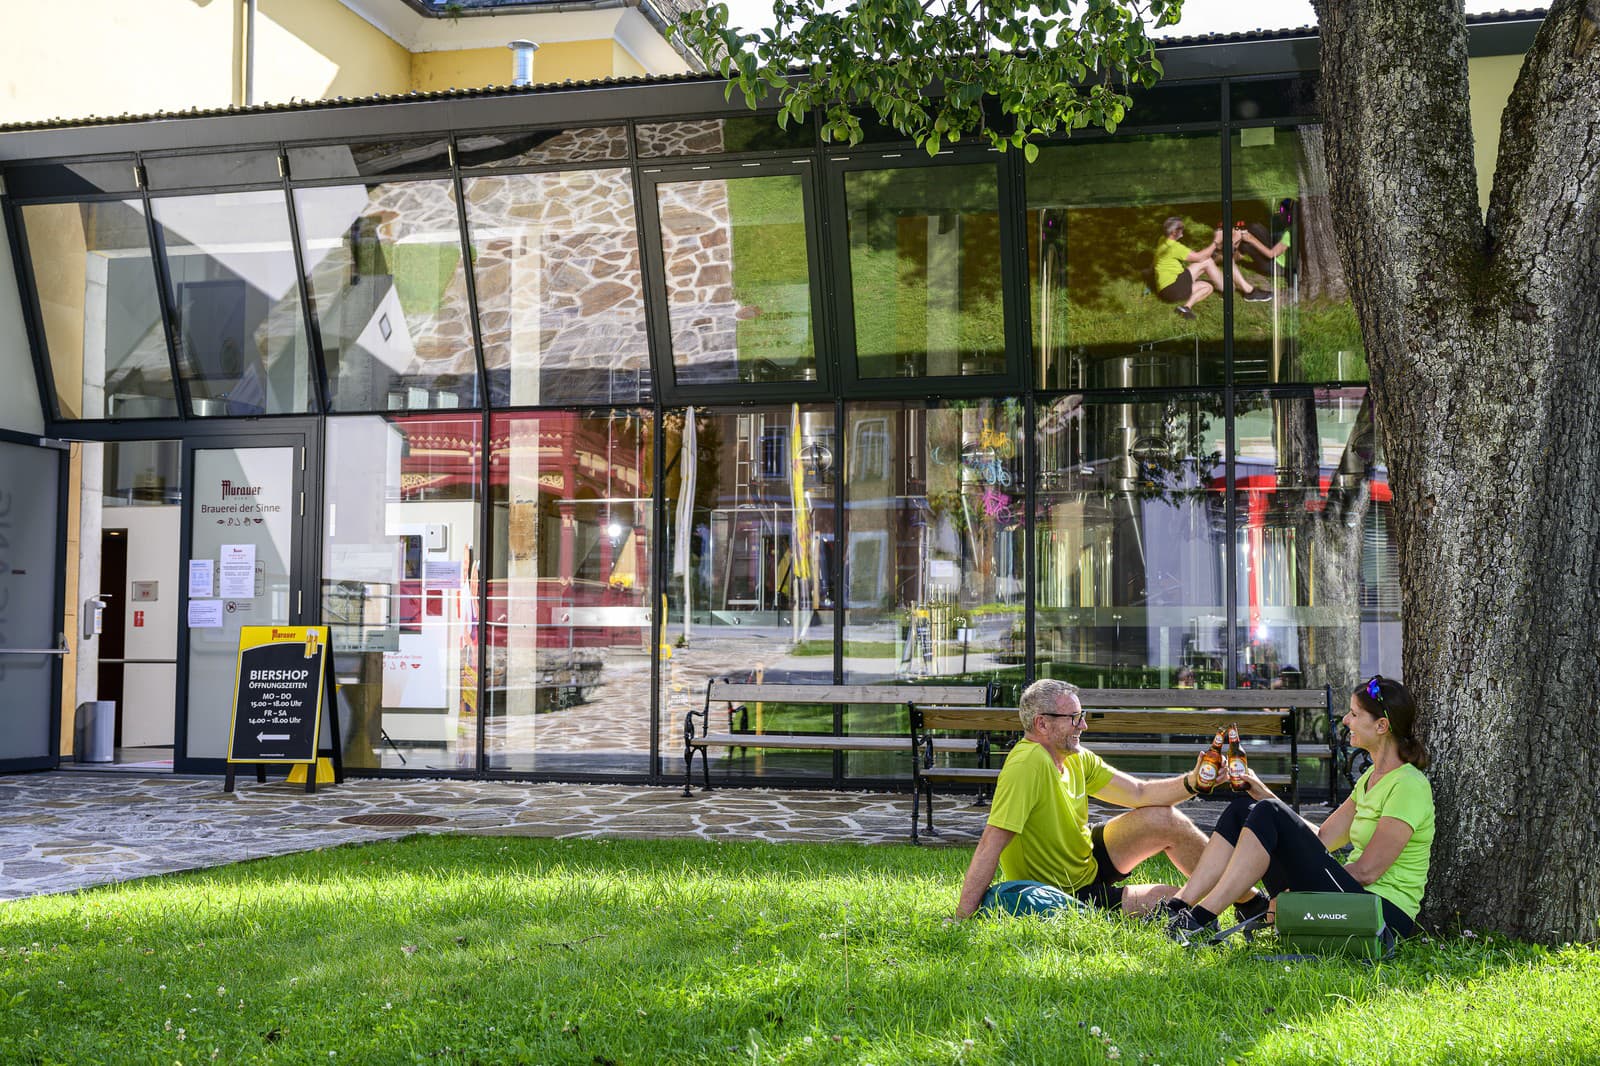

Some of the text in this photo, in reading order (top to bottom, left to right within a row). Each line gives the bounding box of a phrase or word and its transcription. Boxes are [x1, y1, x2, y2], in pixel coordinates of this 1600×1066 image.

[221, 480, 261, 500] Murauer
[201, 503, 280, 513] Brauerei der Sinne
[272, 629, 296, 640] Murauer
[250, 670, 308, 680] BIERSHOP
[249, 681, 307, 689] ÖFFNUNGSZEITEN
